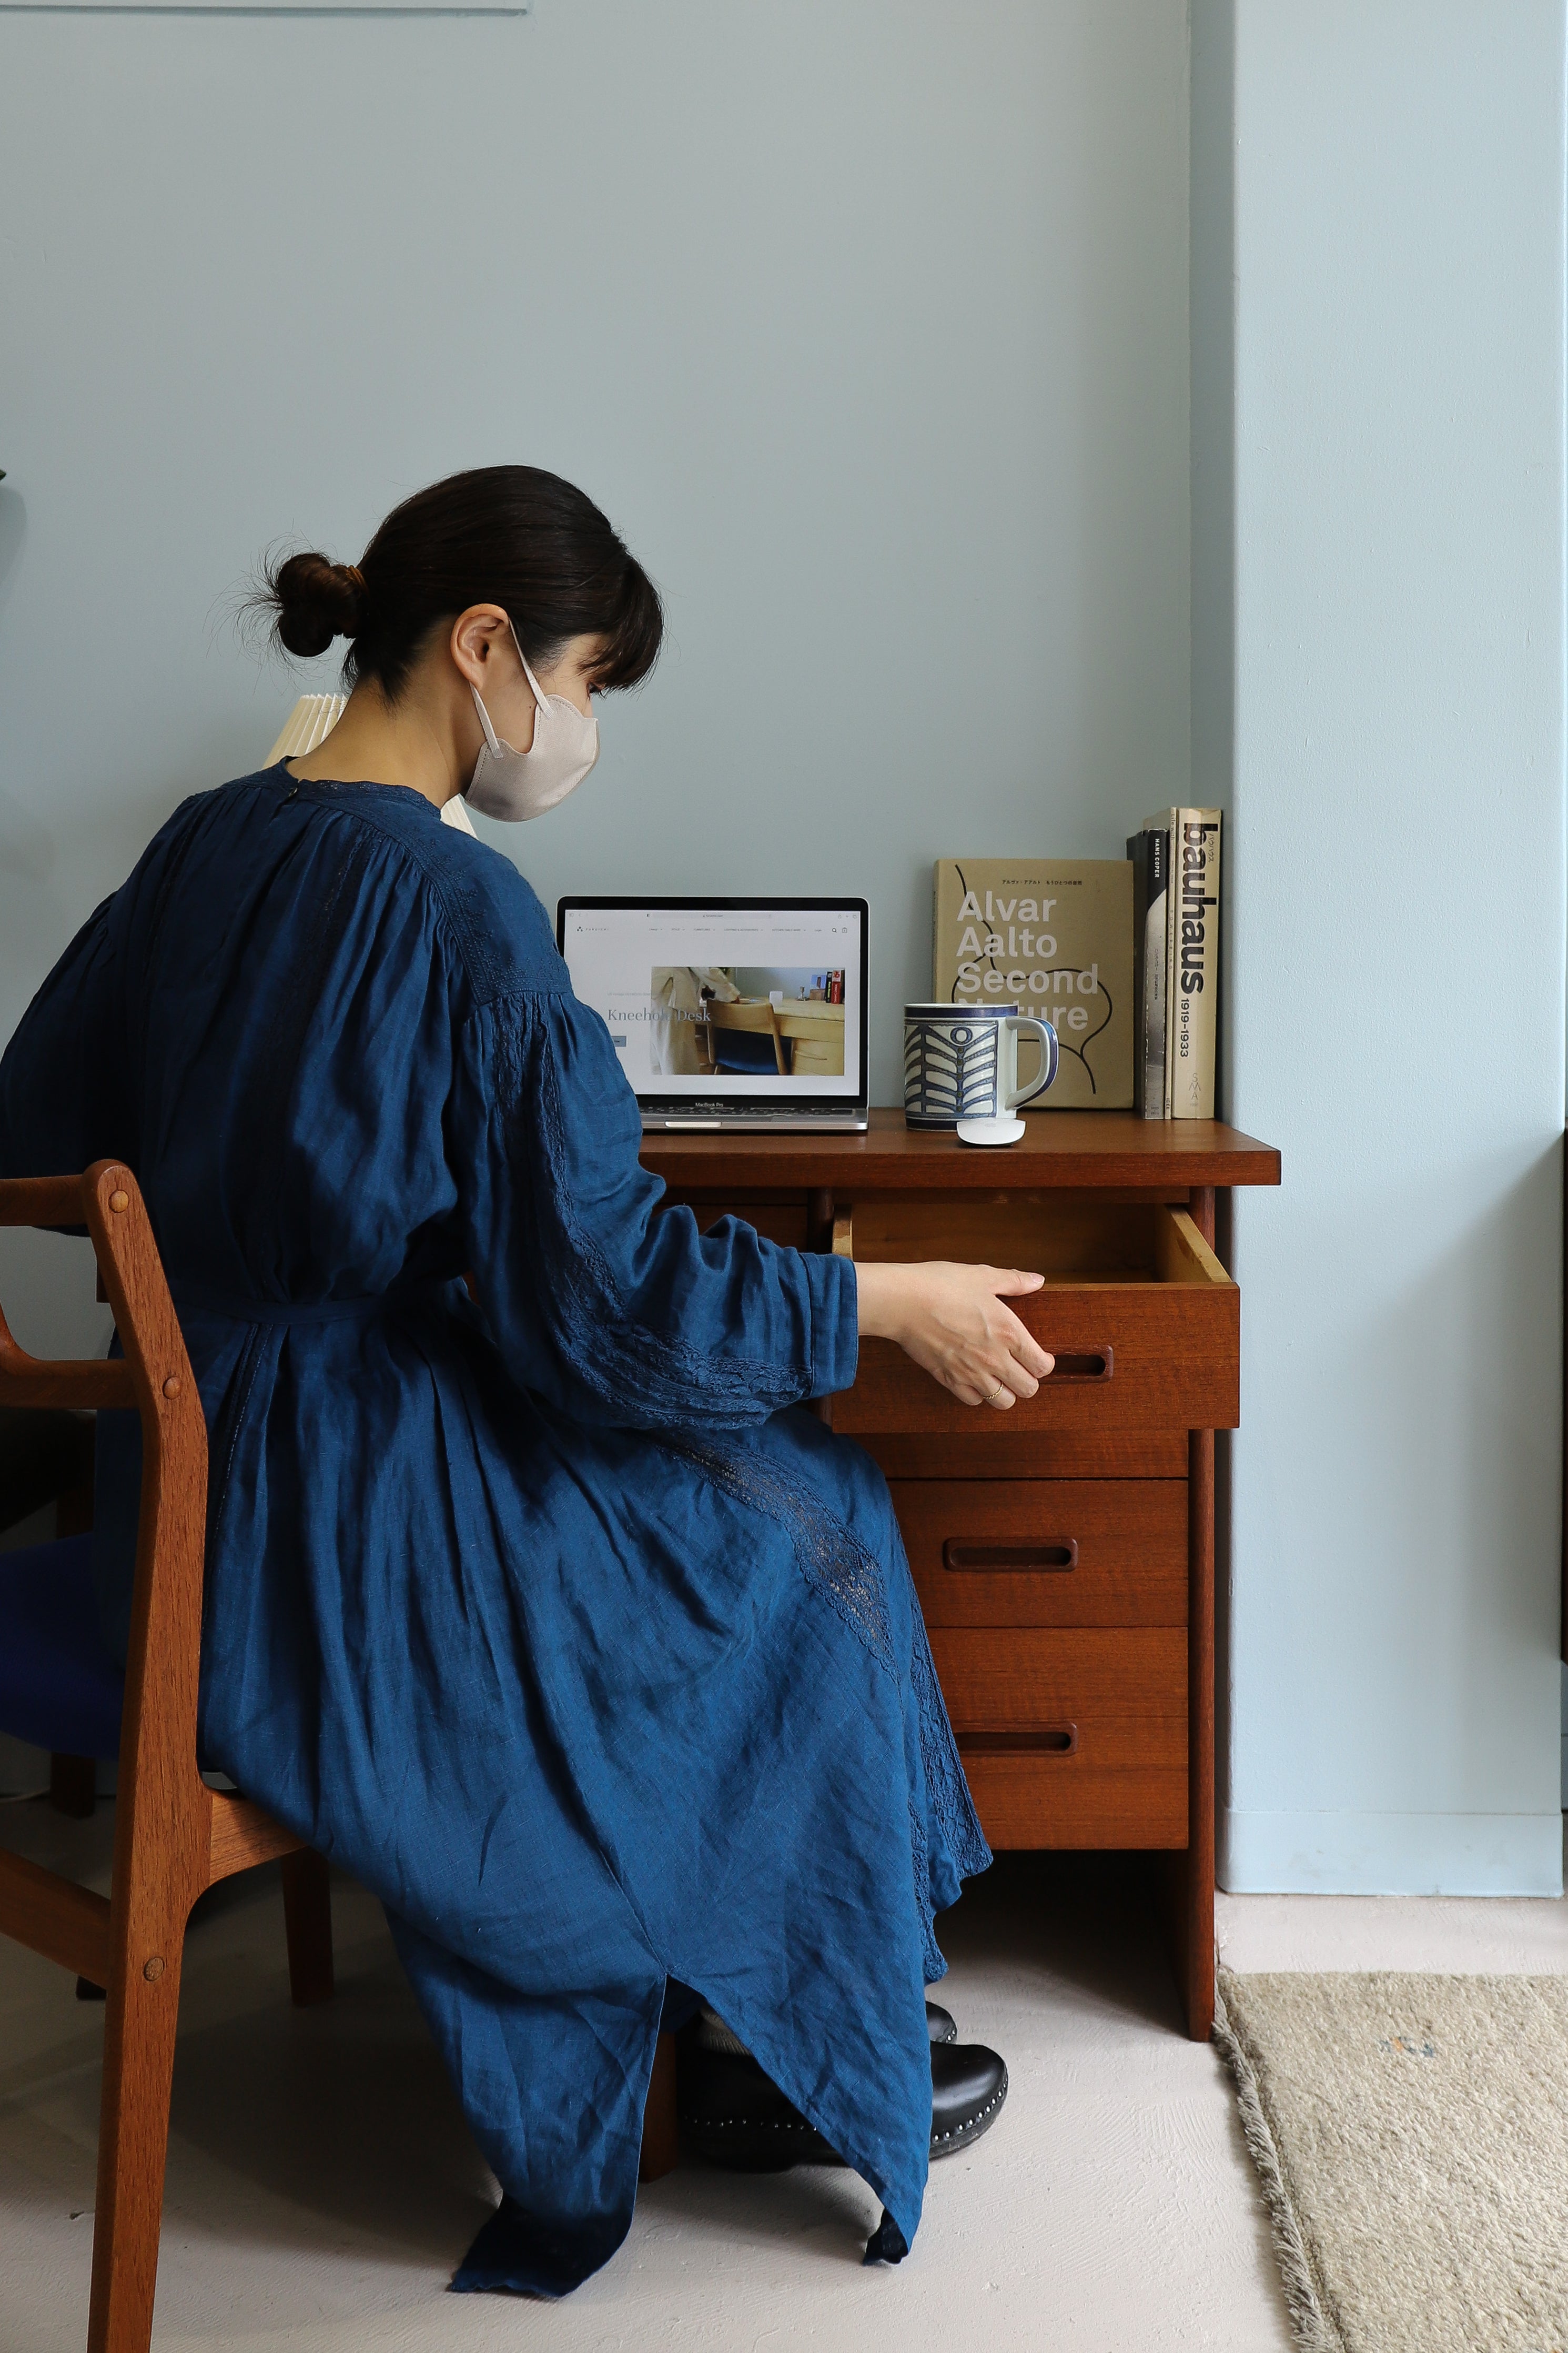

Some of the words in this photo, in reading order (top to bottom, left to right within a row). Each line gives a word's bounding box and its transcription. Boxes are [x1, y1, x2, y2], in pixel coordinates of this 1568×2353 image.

[956, 890, 1057, 922] Alvar
[1181, 823, 1218, 994] bauhaus
[956, 926, 1058, 958] Aalto
[956, 962, 1098, 994] Second
[677, 1008, 711, 1022] Desk
[1180, 998, 1189, 1058] 1919-1933
